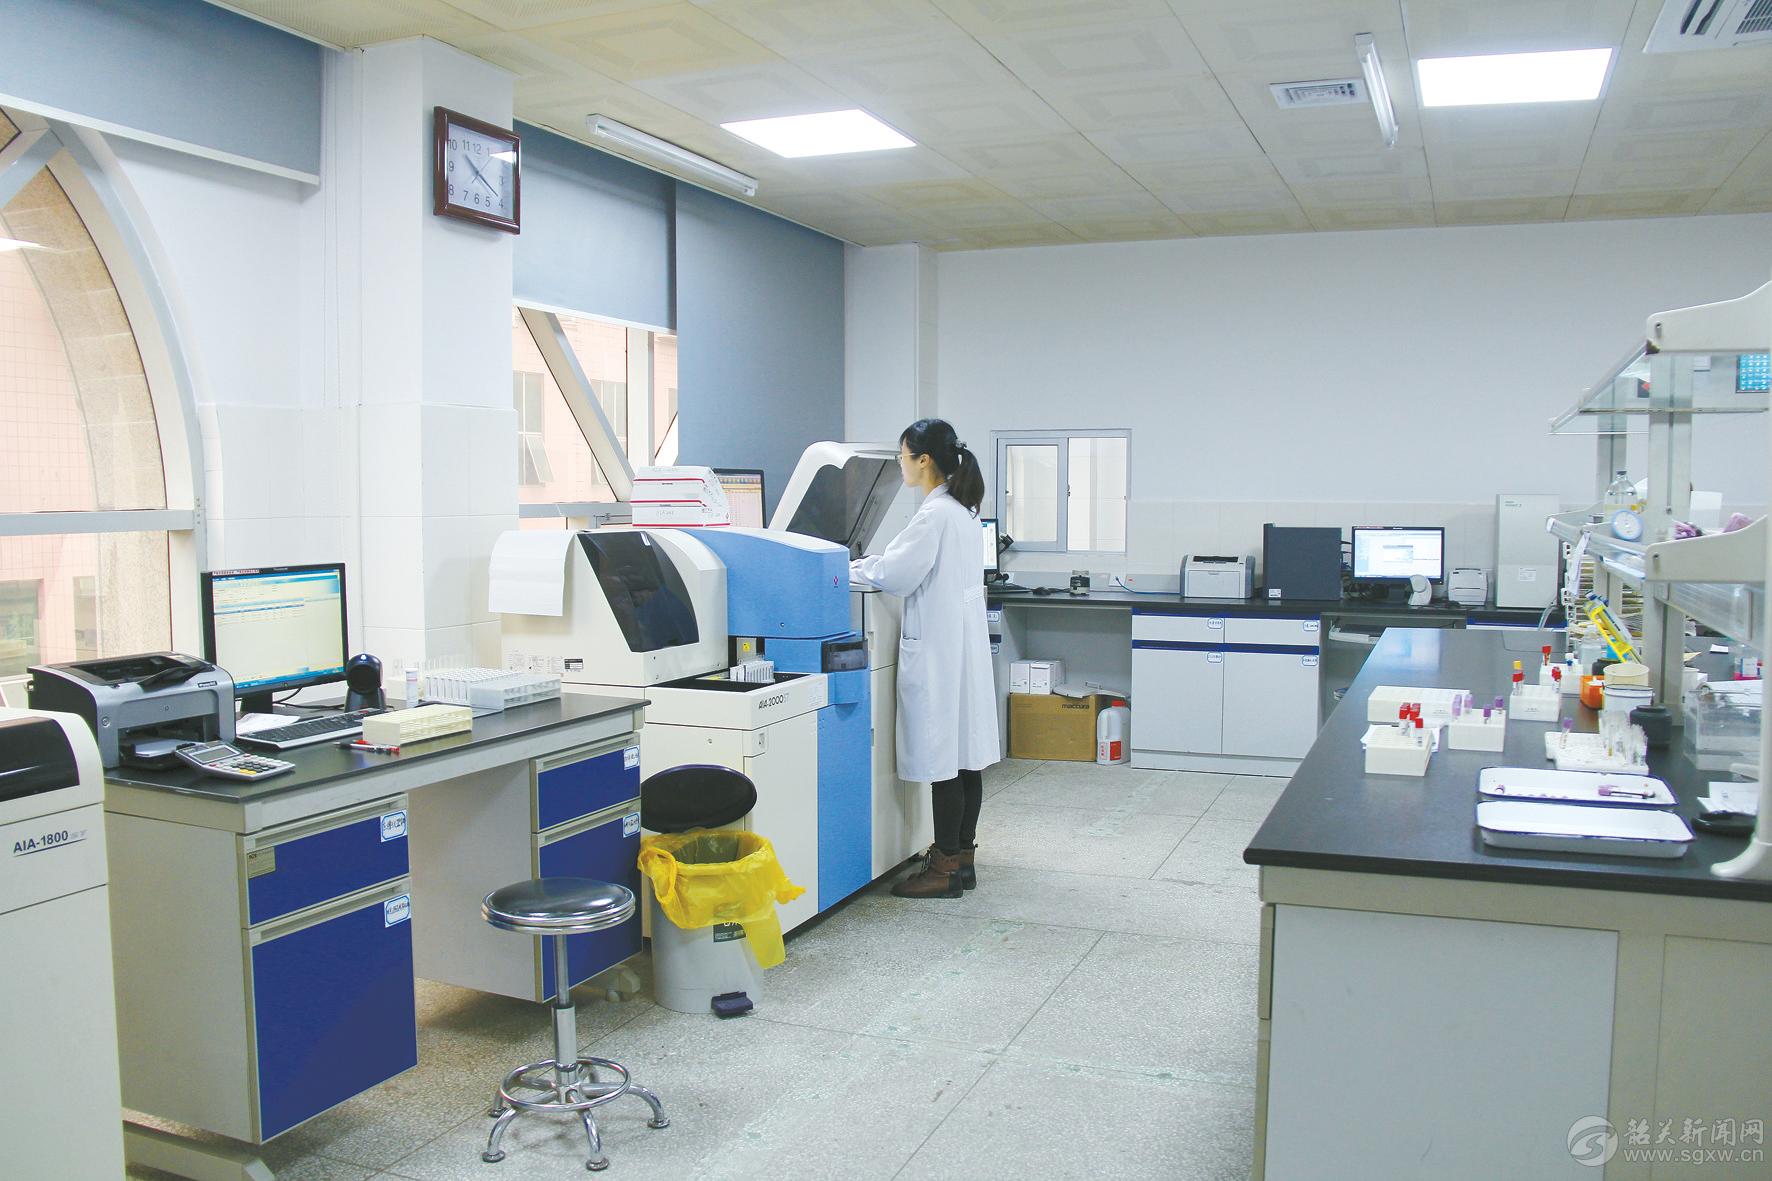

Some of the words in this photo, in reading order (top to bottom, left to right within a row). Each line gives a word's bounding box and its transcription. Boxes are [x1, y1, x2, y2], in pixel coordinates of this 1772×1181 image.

[448, 139, 458, 151] 10
[462, 139, 471, 152] 11
[473, 143, 482, 155] 12
[448, 161, 454, 172] 9
[448, 184, 454, 196] 8
[463, 190, 469, 201] 7
[474, 193, 480, 205] 6
[485, 196, 491, 208] 5
[498, 199, 504, 209] 4
[13, 830, 69, 854] AIA-1800
